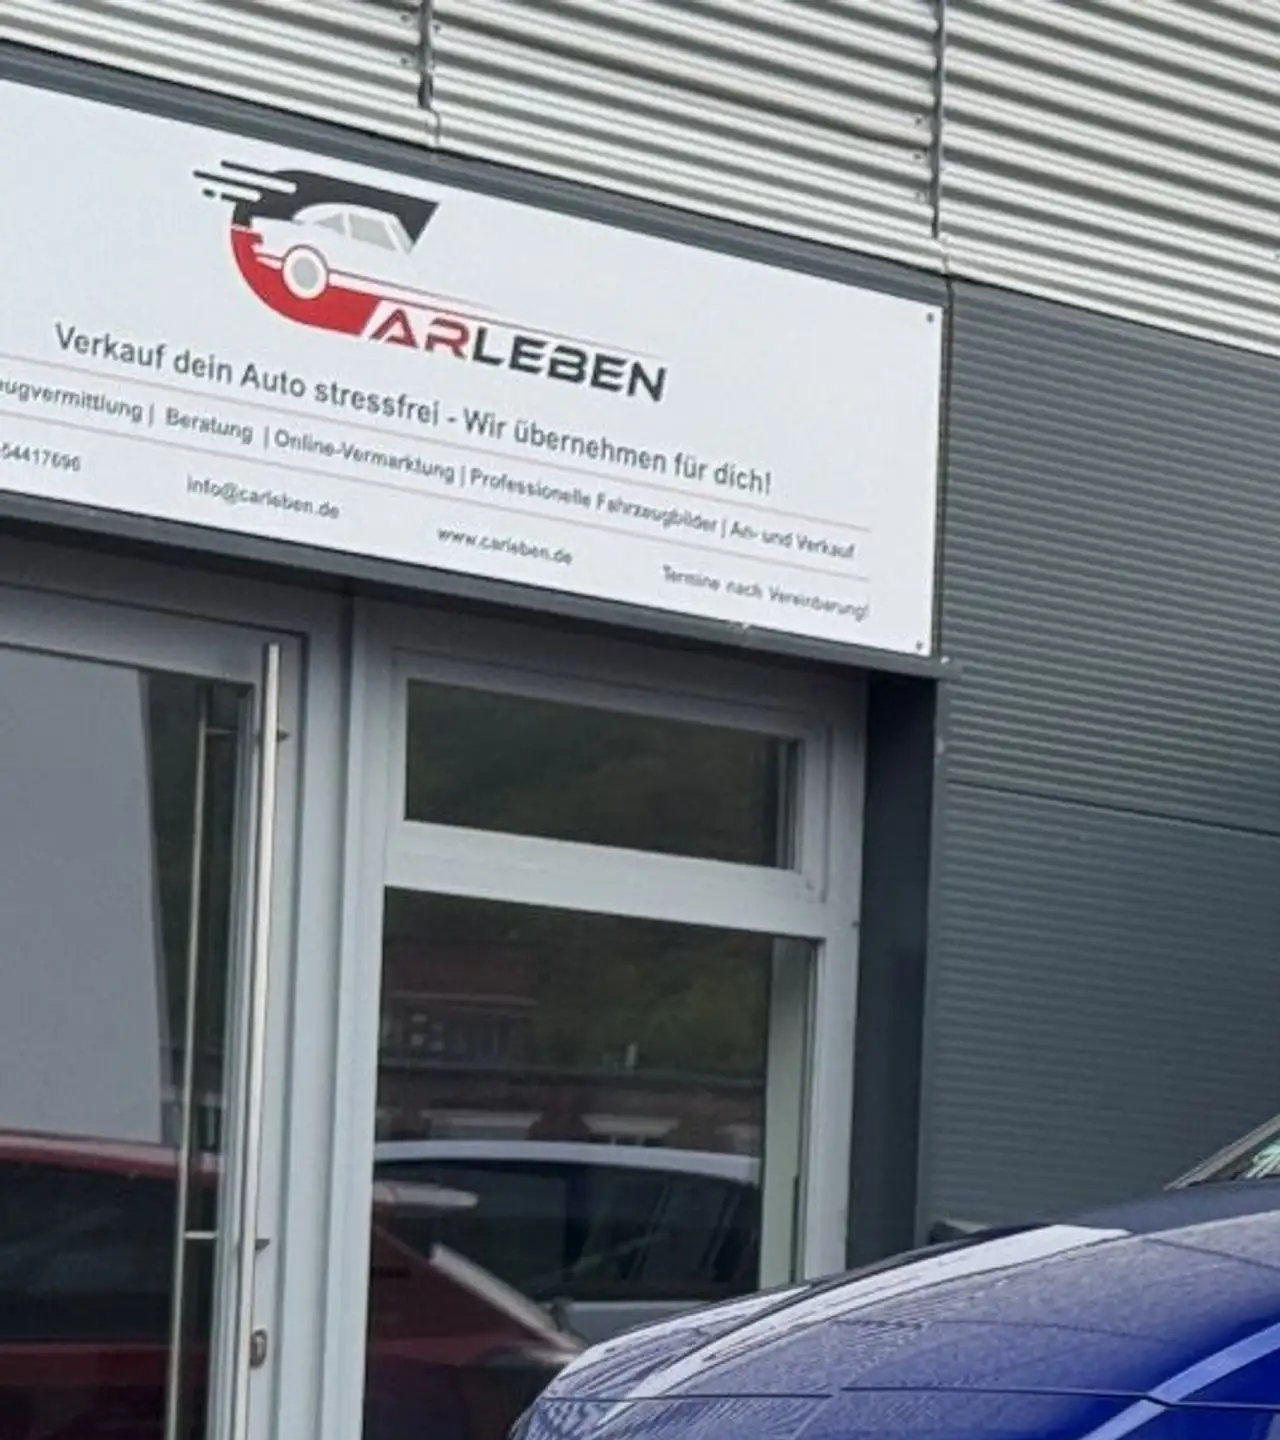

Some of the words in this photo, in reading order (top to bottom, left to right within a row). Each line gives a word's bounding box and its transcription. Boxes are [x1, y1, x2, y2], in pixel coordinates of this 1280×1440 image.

[54, 320, 168, 371] Verkauf
[173, 350, 233, 385] dein
[240, 362, 307, 398] Auto
[314, 381, 440, 427] stressfrei
[463, 406, 507, 440] Wir
[514, 419, 667, 474] übernehmen
[675, 451, 707, 482] für
[713, 463, 772, 496] dich!
[165, 407, 254, 445] Beratung
[274, 428, 455, 485] Online-Vermarktung
[470, 467, 592, 509] Professionelle
[596, 492, 718, 532] Fahrzeugbilder
[762, 529, 794, 549] und
[797, 533, 856, 560] Verkauf
[187, 473, 341, 520] info@carleben.de
[437, 526, 574, 566] www.carleben.de
[662, 564, 721, 592] Termine
[726, 580, 763, 599] nach
